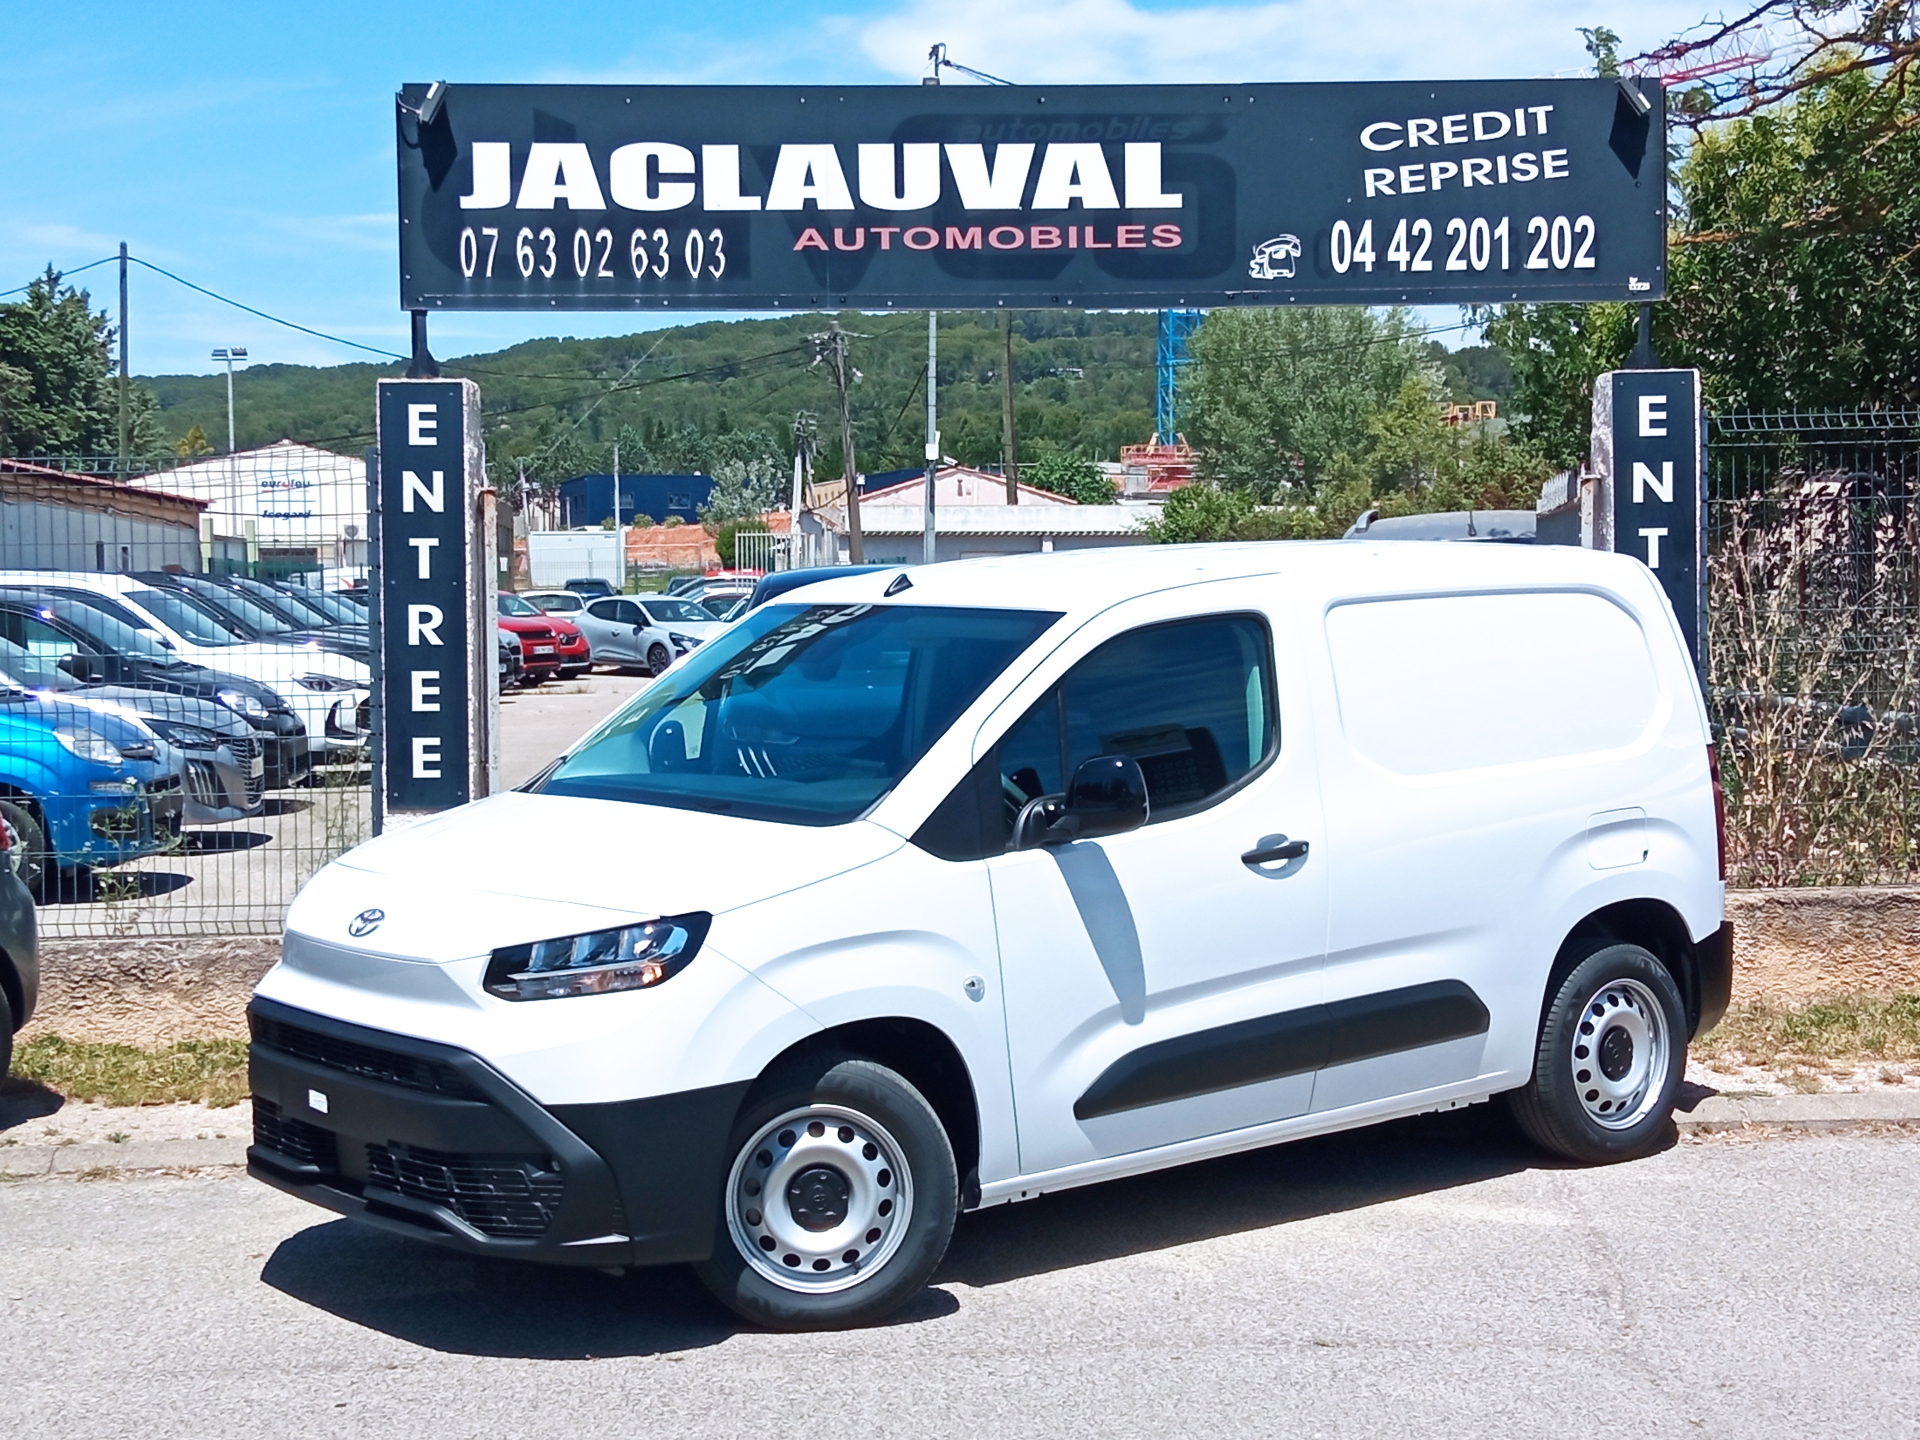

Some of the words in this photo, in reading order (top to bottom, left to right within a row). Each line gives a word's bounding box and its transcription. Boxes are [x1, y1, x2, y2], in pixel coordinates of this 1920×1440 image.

[1360, 105, 1555, 153] CREDIT
[459, 142, 1183, 211] JACLAUVAL
[1363, 149, 1570, 197] REPRISE
[460, 226, 499, 278] 07
[516, 226, 558, 279] 63
[573, 227, 614, 279] 02
[630, 228, 670, 279] 63
[684, 228, 726, 279] 03
[793, 225, 1182, 251] AUTOMOBILES
[1330, 219, 1376, 274] 04
[1387, 218, 1434, 272] 42
[1445, 216, 1510, 271] 201
[1523, 215, 1596, 270] 202
[402, 403, 445, 779] ENTREE
